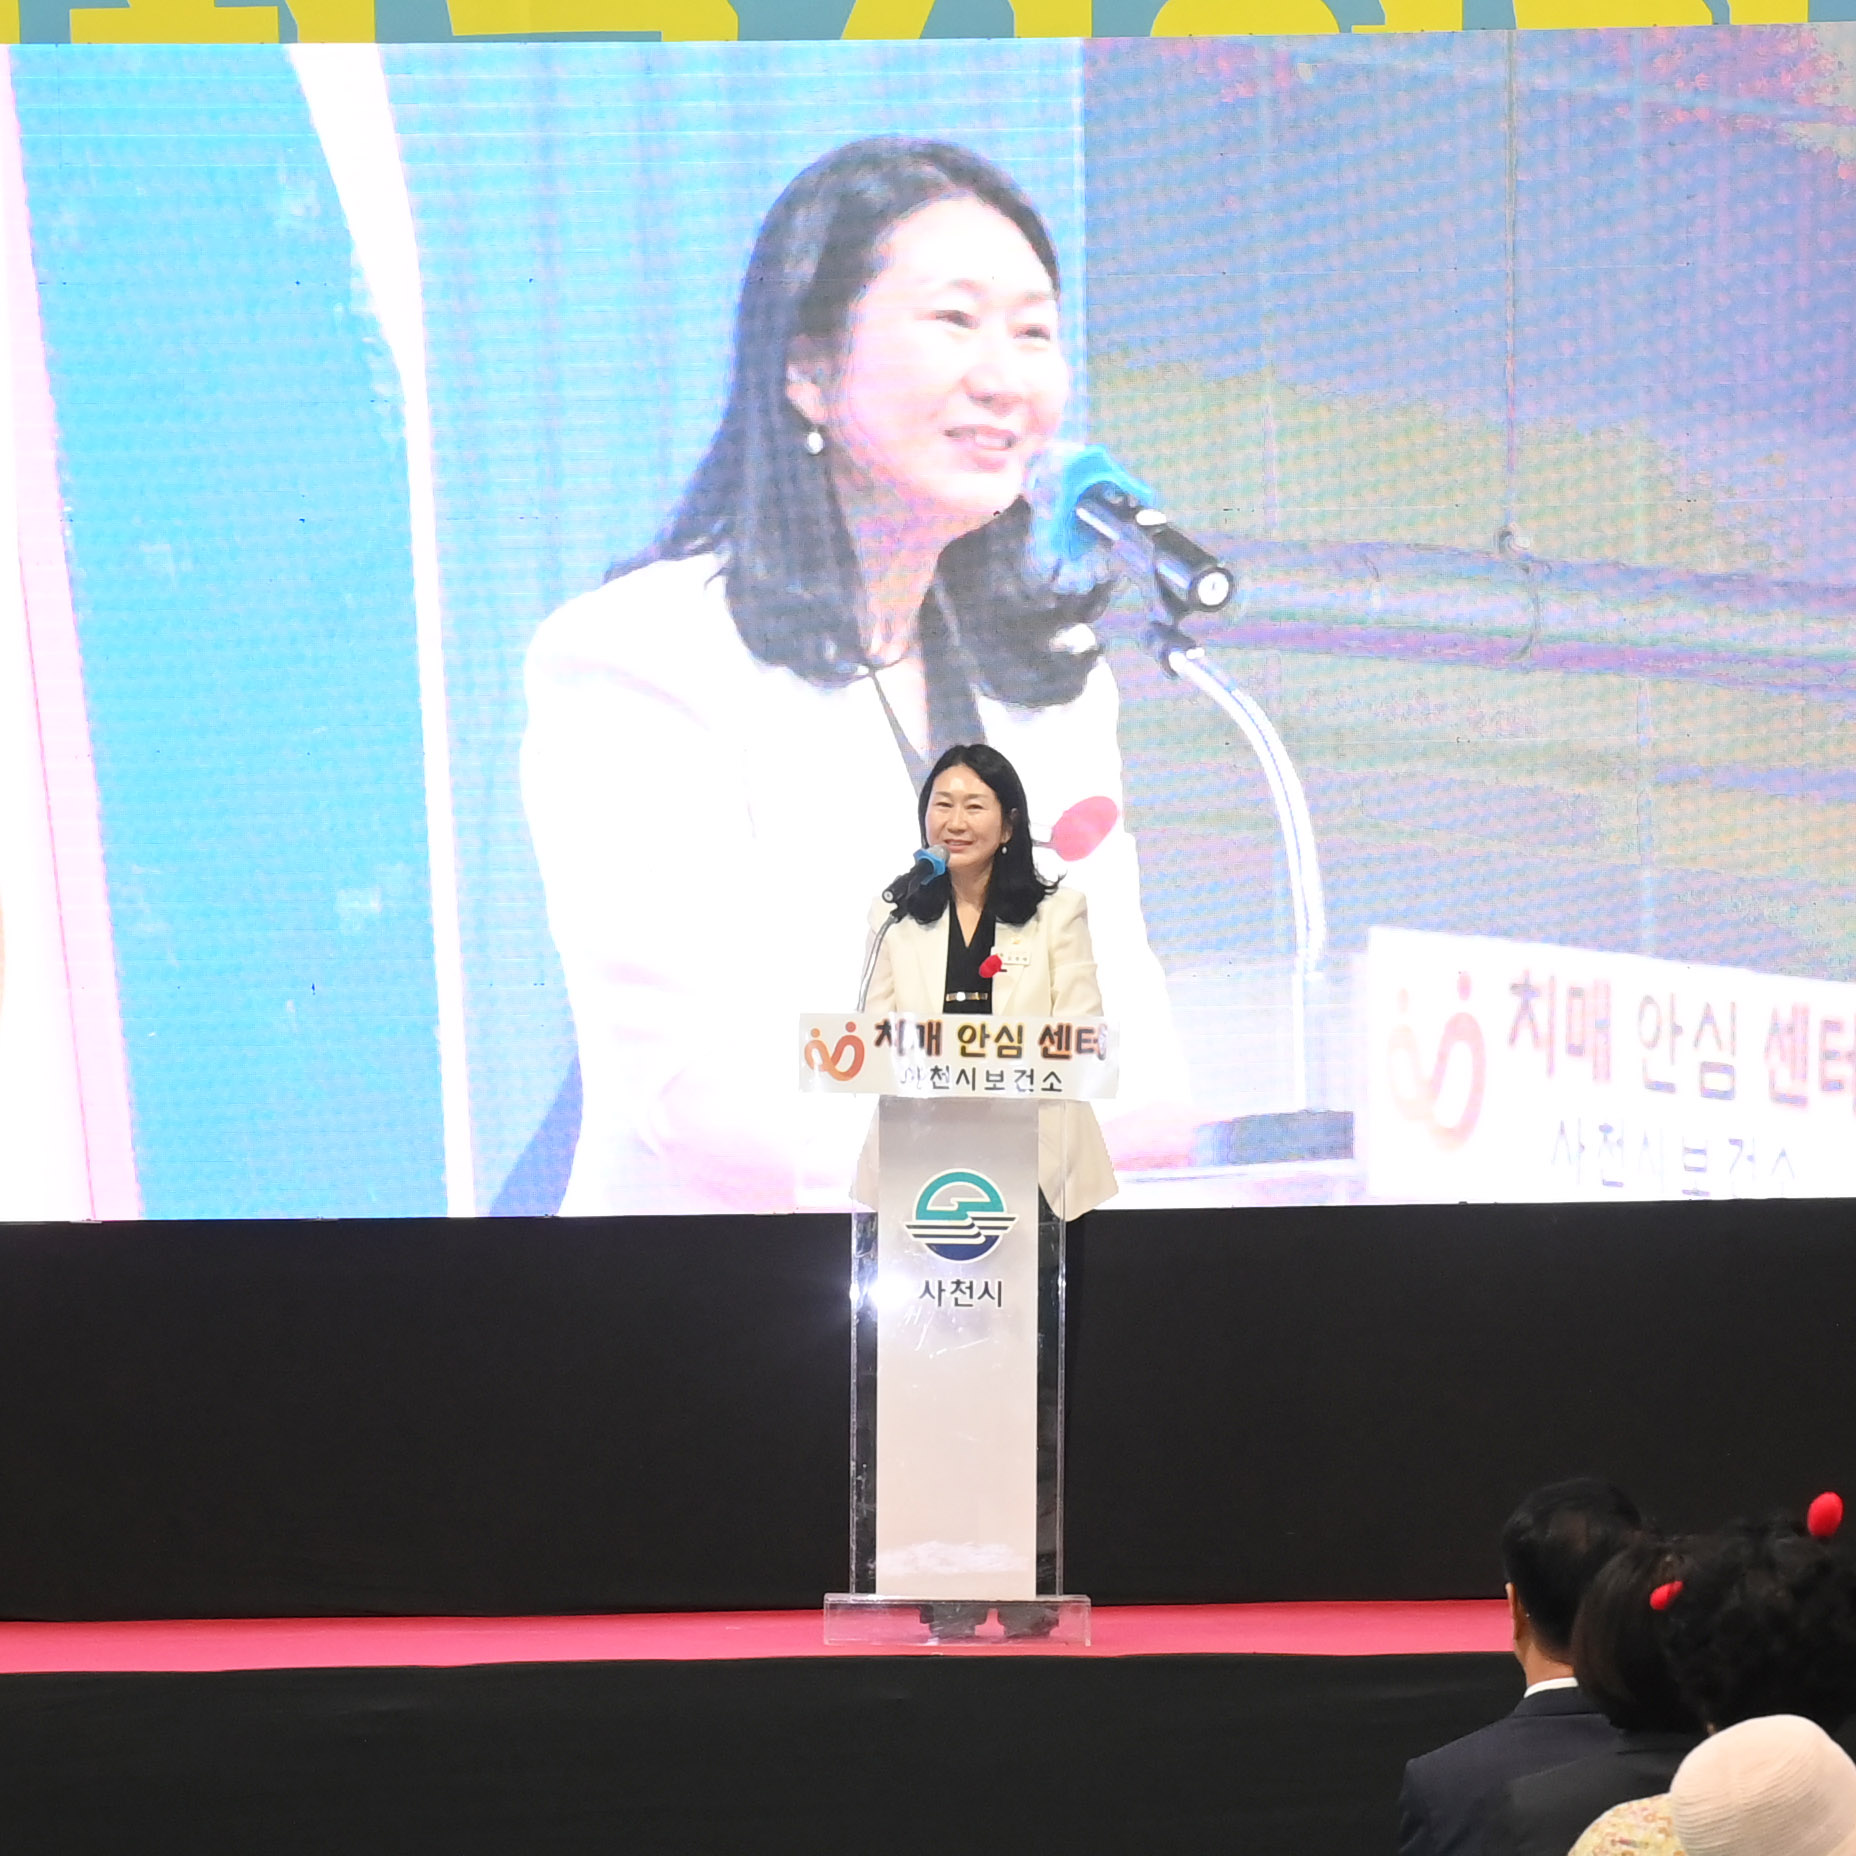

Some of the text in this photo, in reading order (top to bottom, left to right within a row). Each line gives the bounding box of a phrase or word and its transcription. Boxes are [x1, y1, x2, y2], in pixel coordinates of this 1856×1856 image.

[957, 1022, 1024, 1060] 안심
[1038, 1022, 1109, 1061] 센터
[1508, 968, 1612, 1083] 치매
[1638, 992, 1736, 1101] 안심
[919, 1278, 1003, 1308] 사천시
